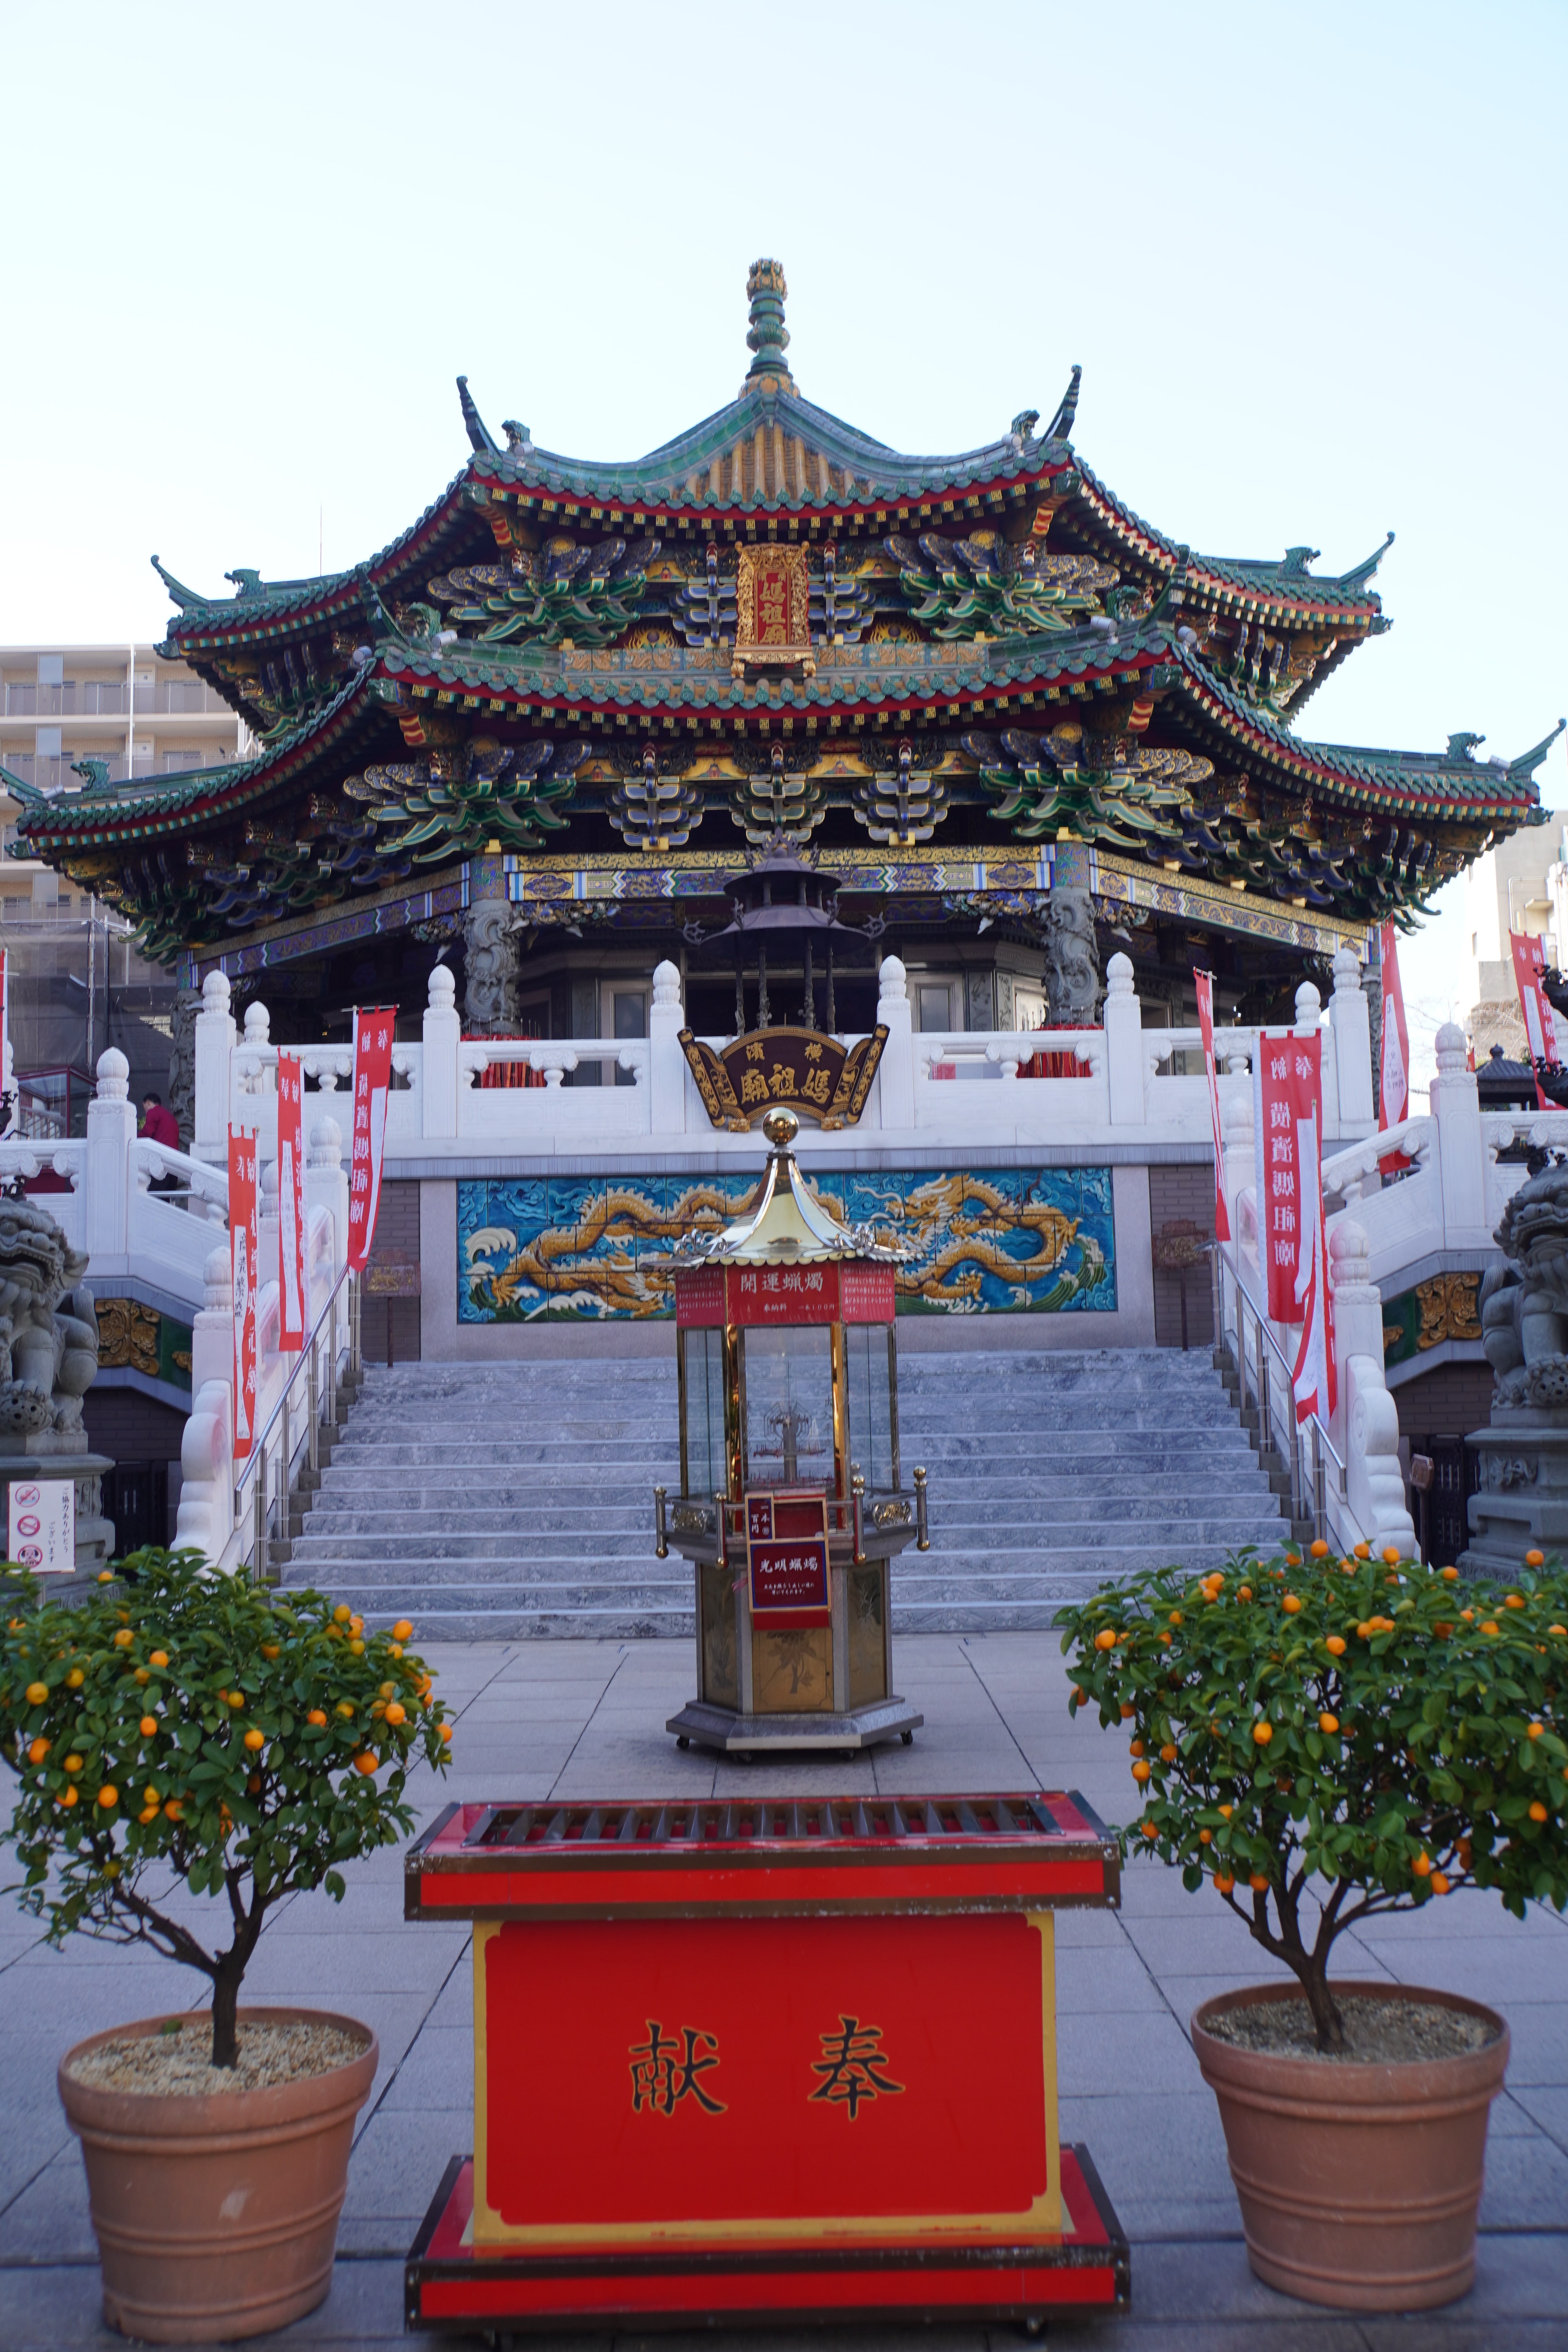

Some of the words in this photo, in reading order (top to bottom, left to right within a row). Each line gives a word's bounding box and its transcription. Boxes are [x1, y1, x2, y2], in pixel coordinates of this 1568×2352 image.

[759, 581, 786, 645] 媽祖廟
[741, 1063, 831, 1105] 媽祖廟
[763, 1302, 787, 1312] 奉納料
[62, 1486, 70, 1554] ご協力ありがとう
[751, 1513, 759, 1534] 百円
